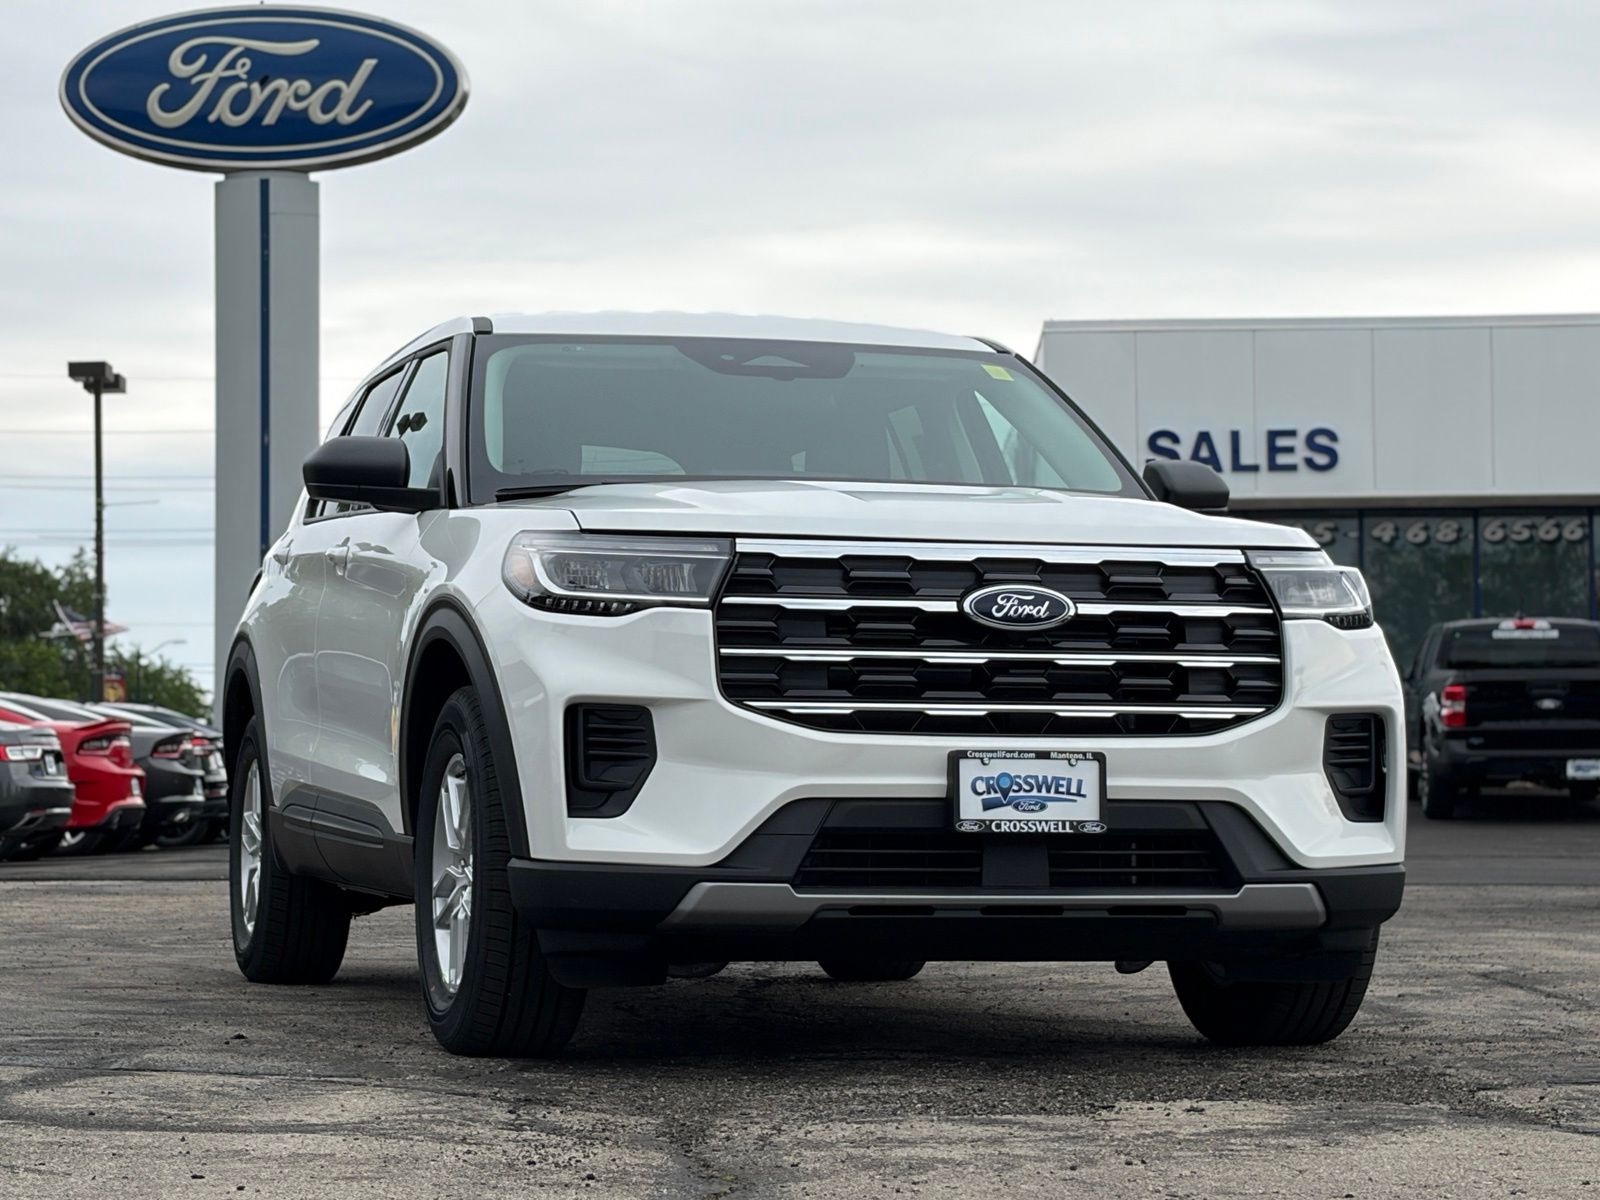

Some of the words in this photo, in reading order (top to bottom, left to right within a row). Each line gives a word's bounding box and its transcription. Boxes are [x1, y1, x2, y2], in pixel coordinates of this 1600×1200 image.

[146, 36, 379, 128] Ford
[1146, 428, 1339, 473] SALES
[992, 593, 1050, 618] Ford
[967, 750, 1036, 759] CrosswellFord.com
[1050, 751, 1085, 760] Manteno,
[1086, 752, 1094, 760] IL
[970, 772, 1087, 799] CROSSWELL
[1017, 800, 1042, 812] Ford
[991, 820, 1074, 833] CROSSWELL
